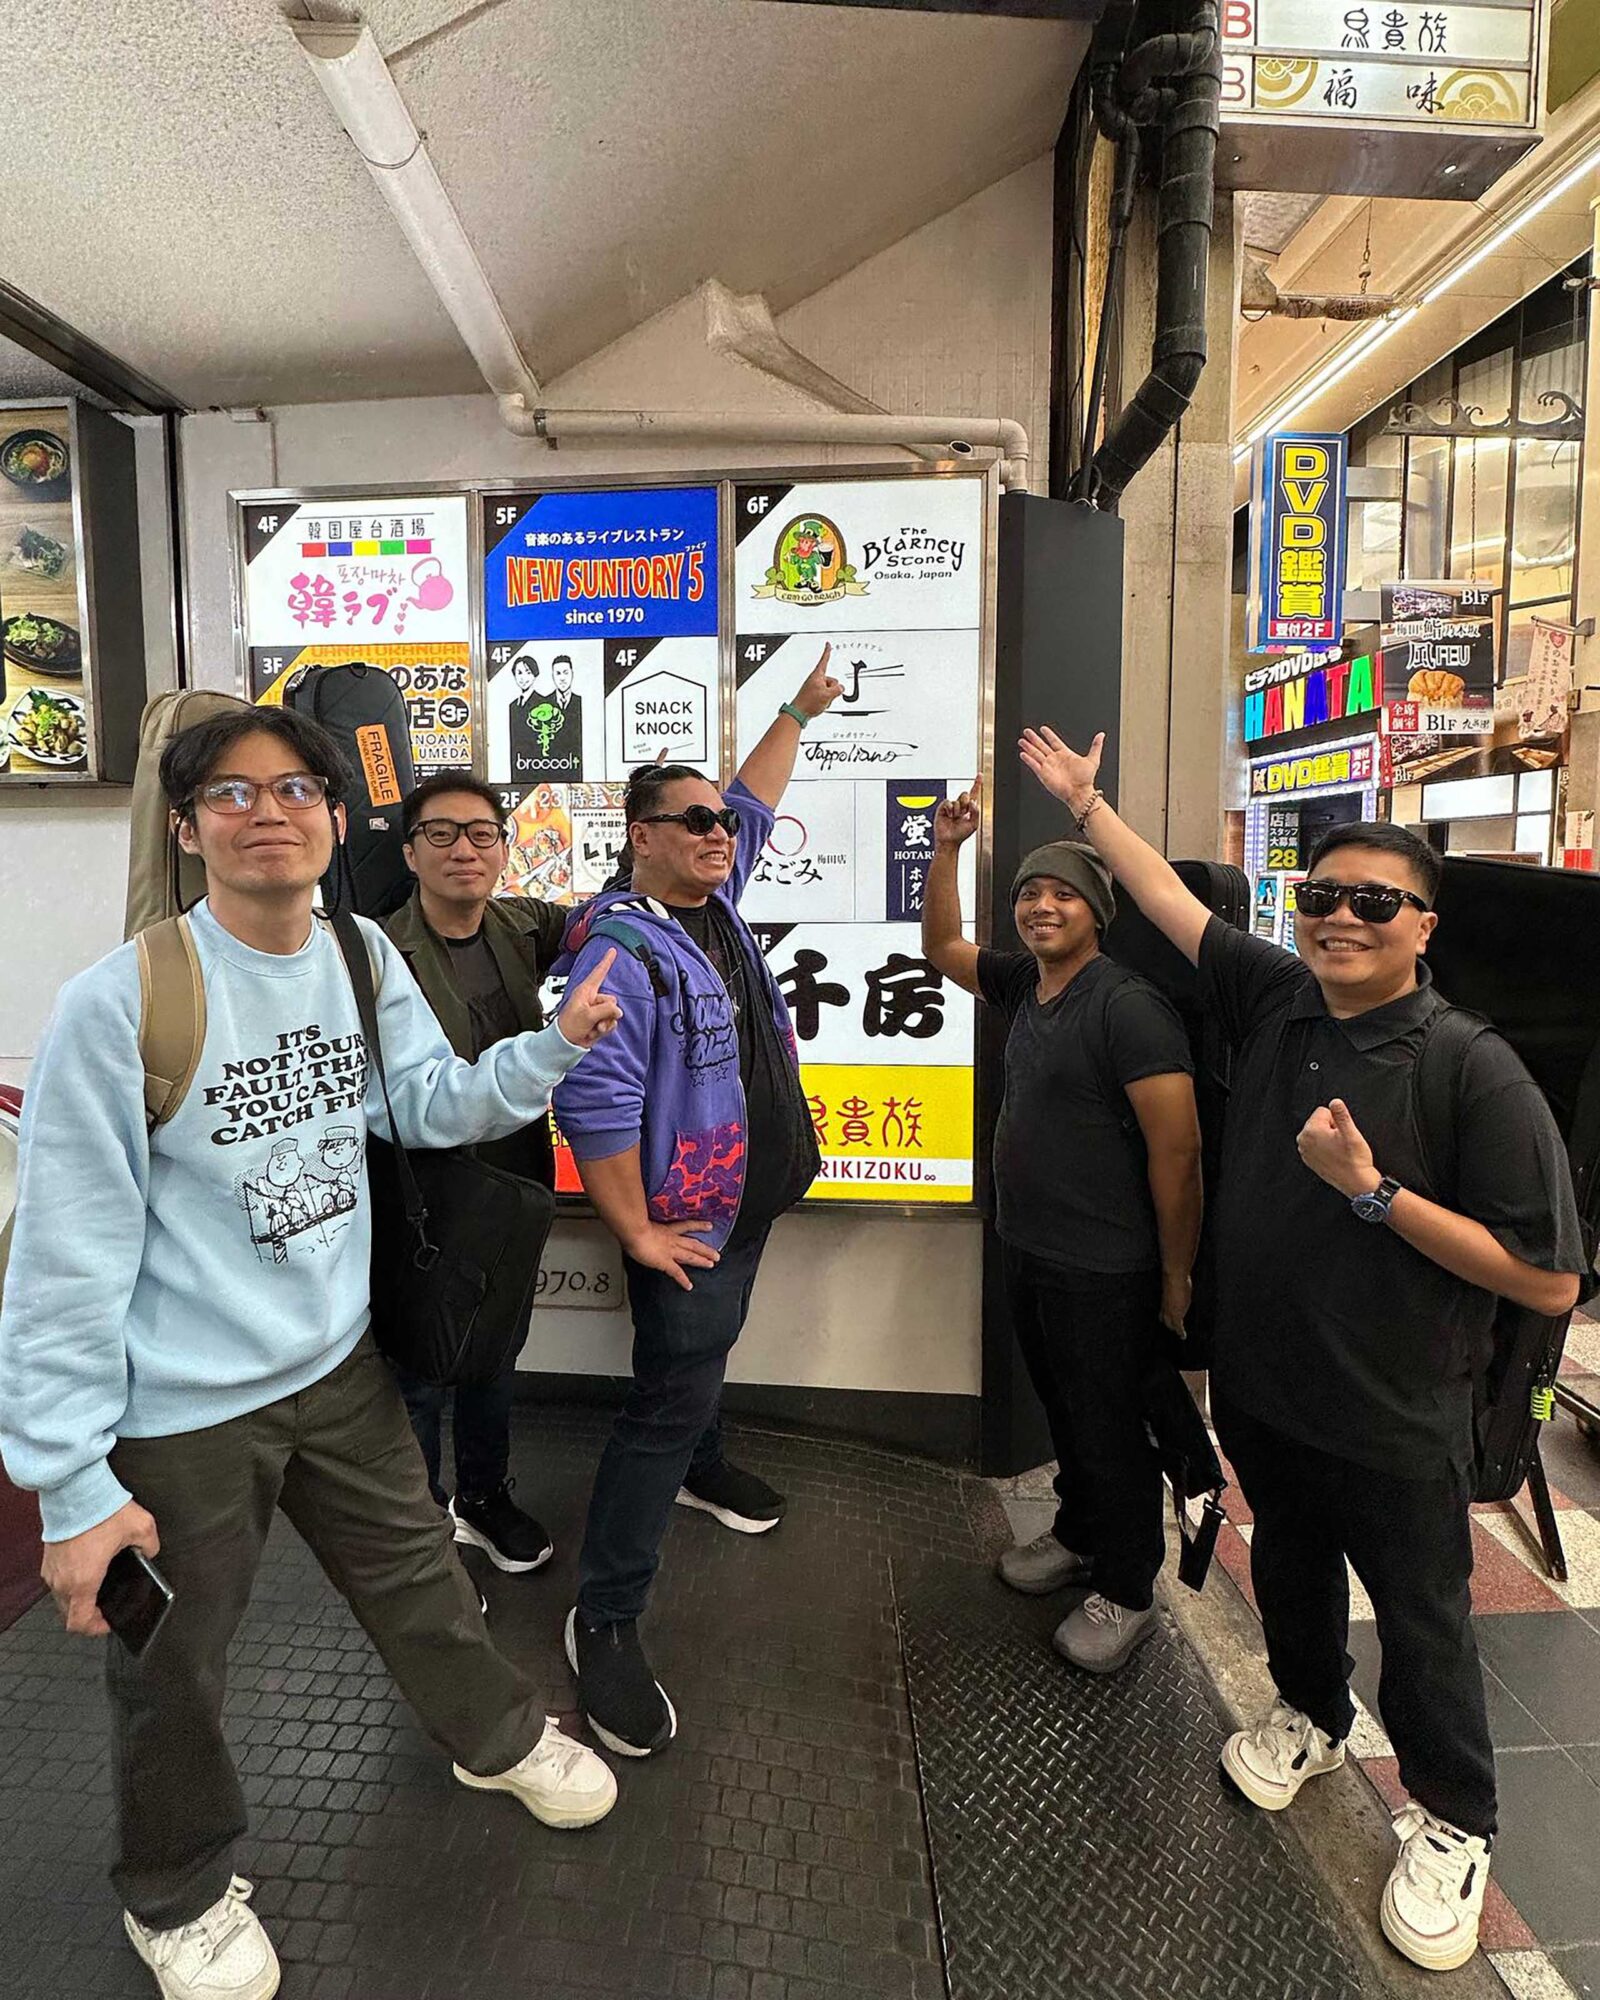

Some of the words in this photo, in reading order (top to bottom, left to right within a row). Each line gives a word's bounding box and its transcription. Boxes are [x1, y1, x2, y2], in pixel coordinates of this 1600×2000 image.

[747, 496, 768, 514] 6F
[257, 516, 278, 533] 4F
[496, 507, 517, 525] 5F
[308, 518, 425, 540] 韓国屋台酒場
[525, 529, 684, 547] 音楽のあるライブレストラン
[900, 527, 927, 535] The
[862, 536, 965, 571] Blarney
[886, 555, 945, 567] Stone
[507, 555, 563, 608] NEW
[567, 553, 685, 599] SUNTORY
[688, 550, 704, 602] 5
[919, 570, 952, 580] Japan
[565, 609, 604, 625] since
[607, 607, 644, 623] 1970
[491, 647, 511, 663] 4F
[615, 649, 637, 666] 4F
[744, 644, 766, 661] 4F
[262, 658, 283, 674] 3F
[635, 701, 693, 715] SNACK
[636, 721, 693, 735] KNOCK
[1426, 714, 1457, 731] B1F
[419, 748, 469, 759] UMEDA
[368, 731, 393, 800] FRAGILE
[500, 792, 520, 808] 2F
[752, 854, 823, 885] なごみ
[909, 866, 923, 910] ホタル
[222, 1052, 293, 1080] NOT
[298, 1033, 365, 1063] YOUR
[203, 1067, 303, 1105] FAULT
[221, 1092, 292, 1122] YOU
[211, 1103, 315, 1145] CATCH
